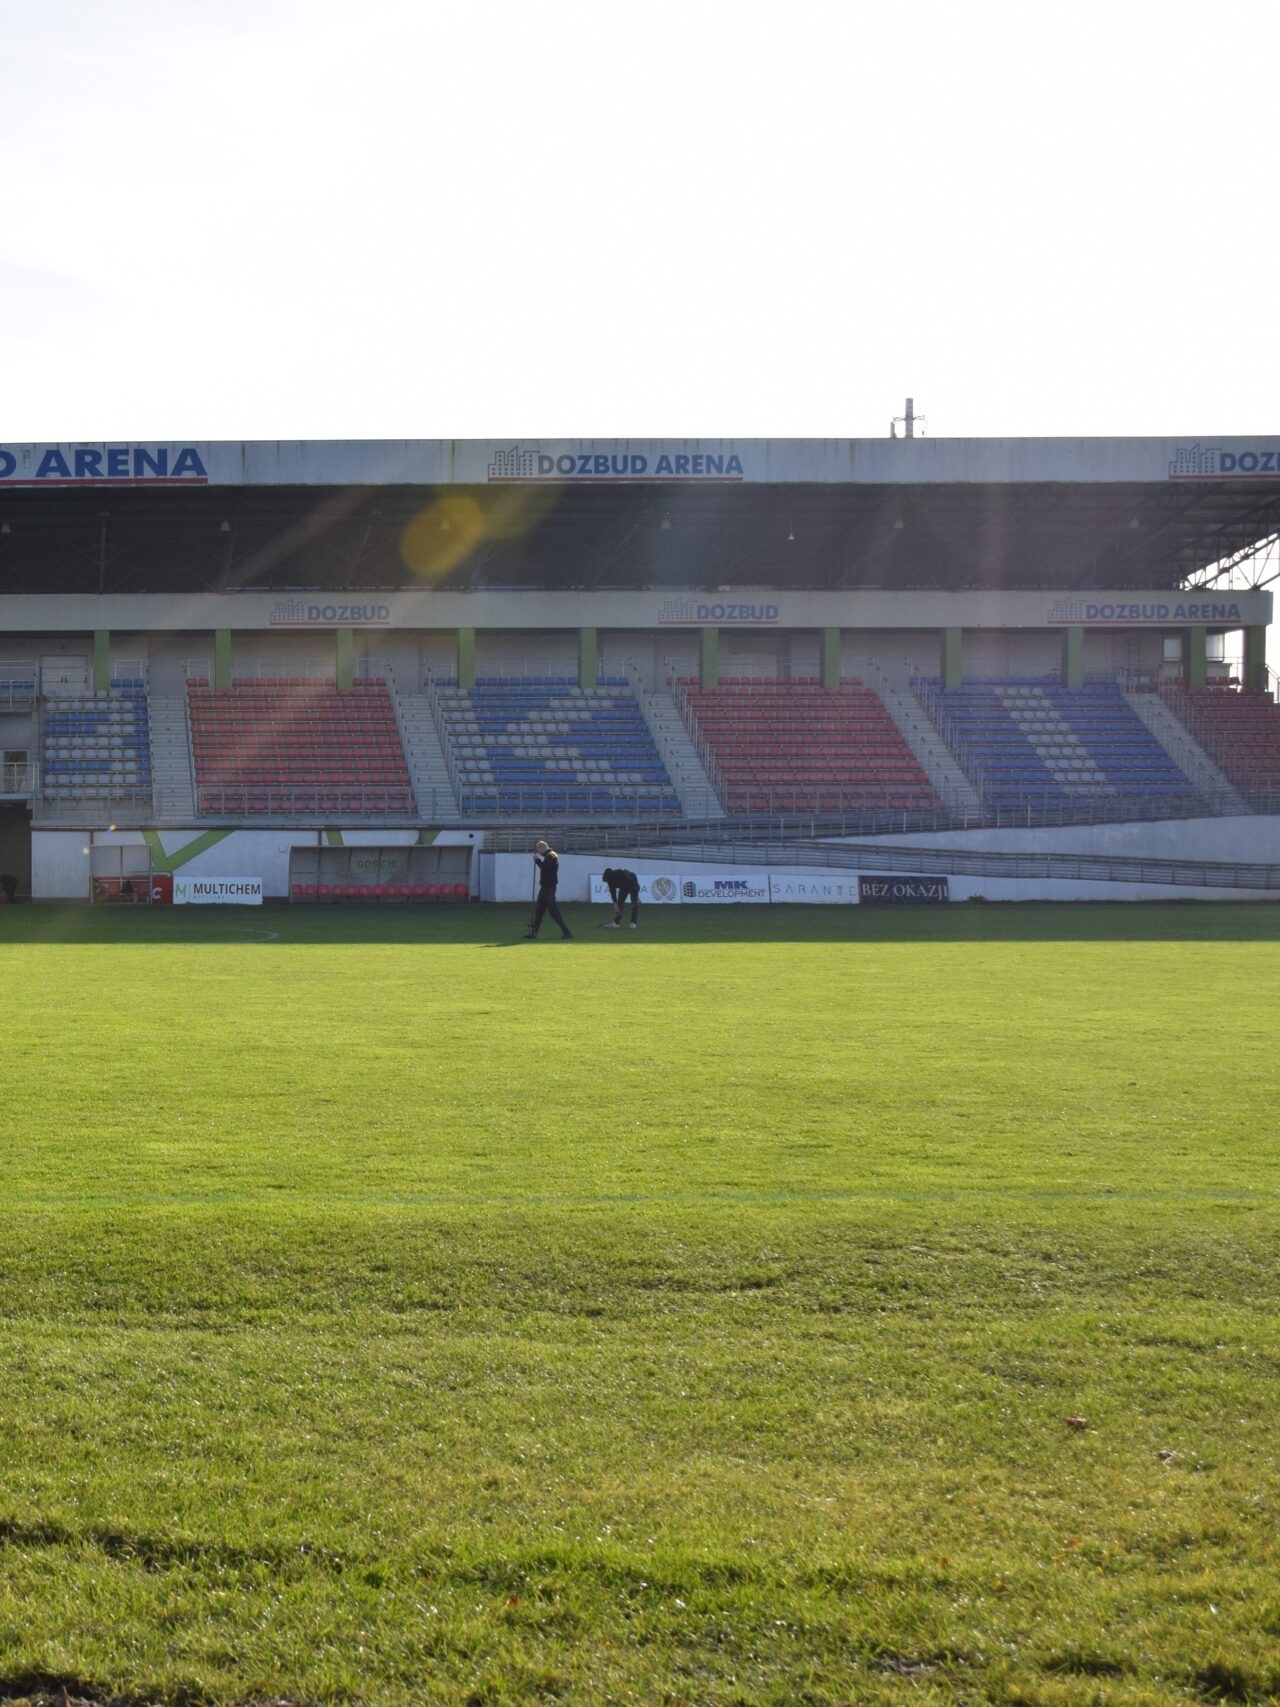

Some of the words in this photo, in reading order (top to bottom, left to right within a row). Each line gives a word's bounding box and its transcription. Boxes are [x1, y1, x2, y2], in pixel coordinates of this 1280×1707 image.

[35, 448, 208, 478] ARENA
[537, 454, 648, 475] DOZBUD
[654, 454, 744, 475] ARENA
[1220, 451, 1280, 473] DOZ
[307, 605, 391, 621] DOZBUD
[696, 604, 779, 620] DOZBUD
[1085, 604, 1170, 619] DOZBUD
[1173, 603, 1241, 619] ARENA
[193, 883, 261, 895] MULTICHEM
[714, 880, 749, 890] MK
[862, 883, 890, 897] BEZ
[894, 883, 948, 900] OKAZJI
[698, 889, 766, 898] DEVELOPMENT
